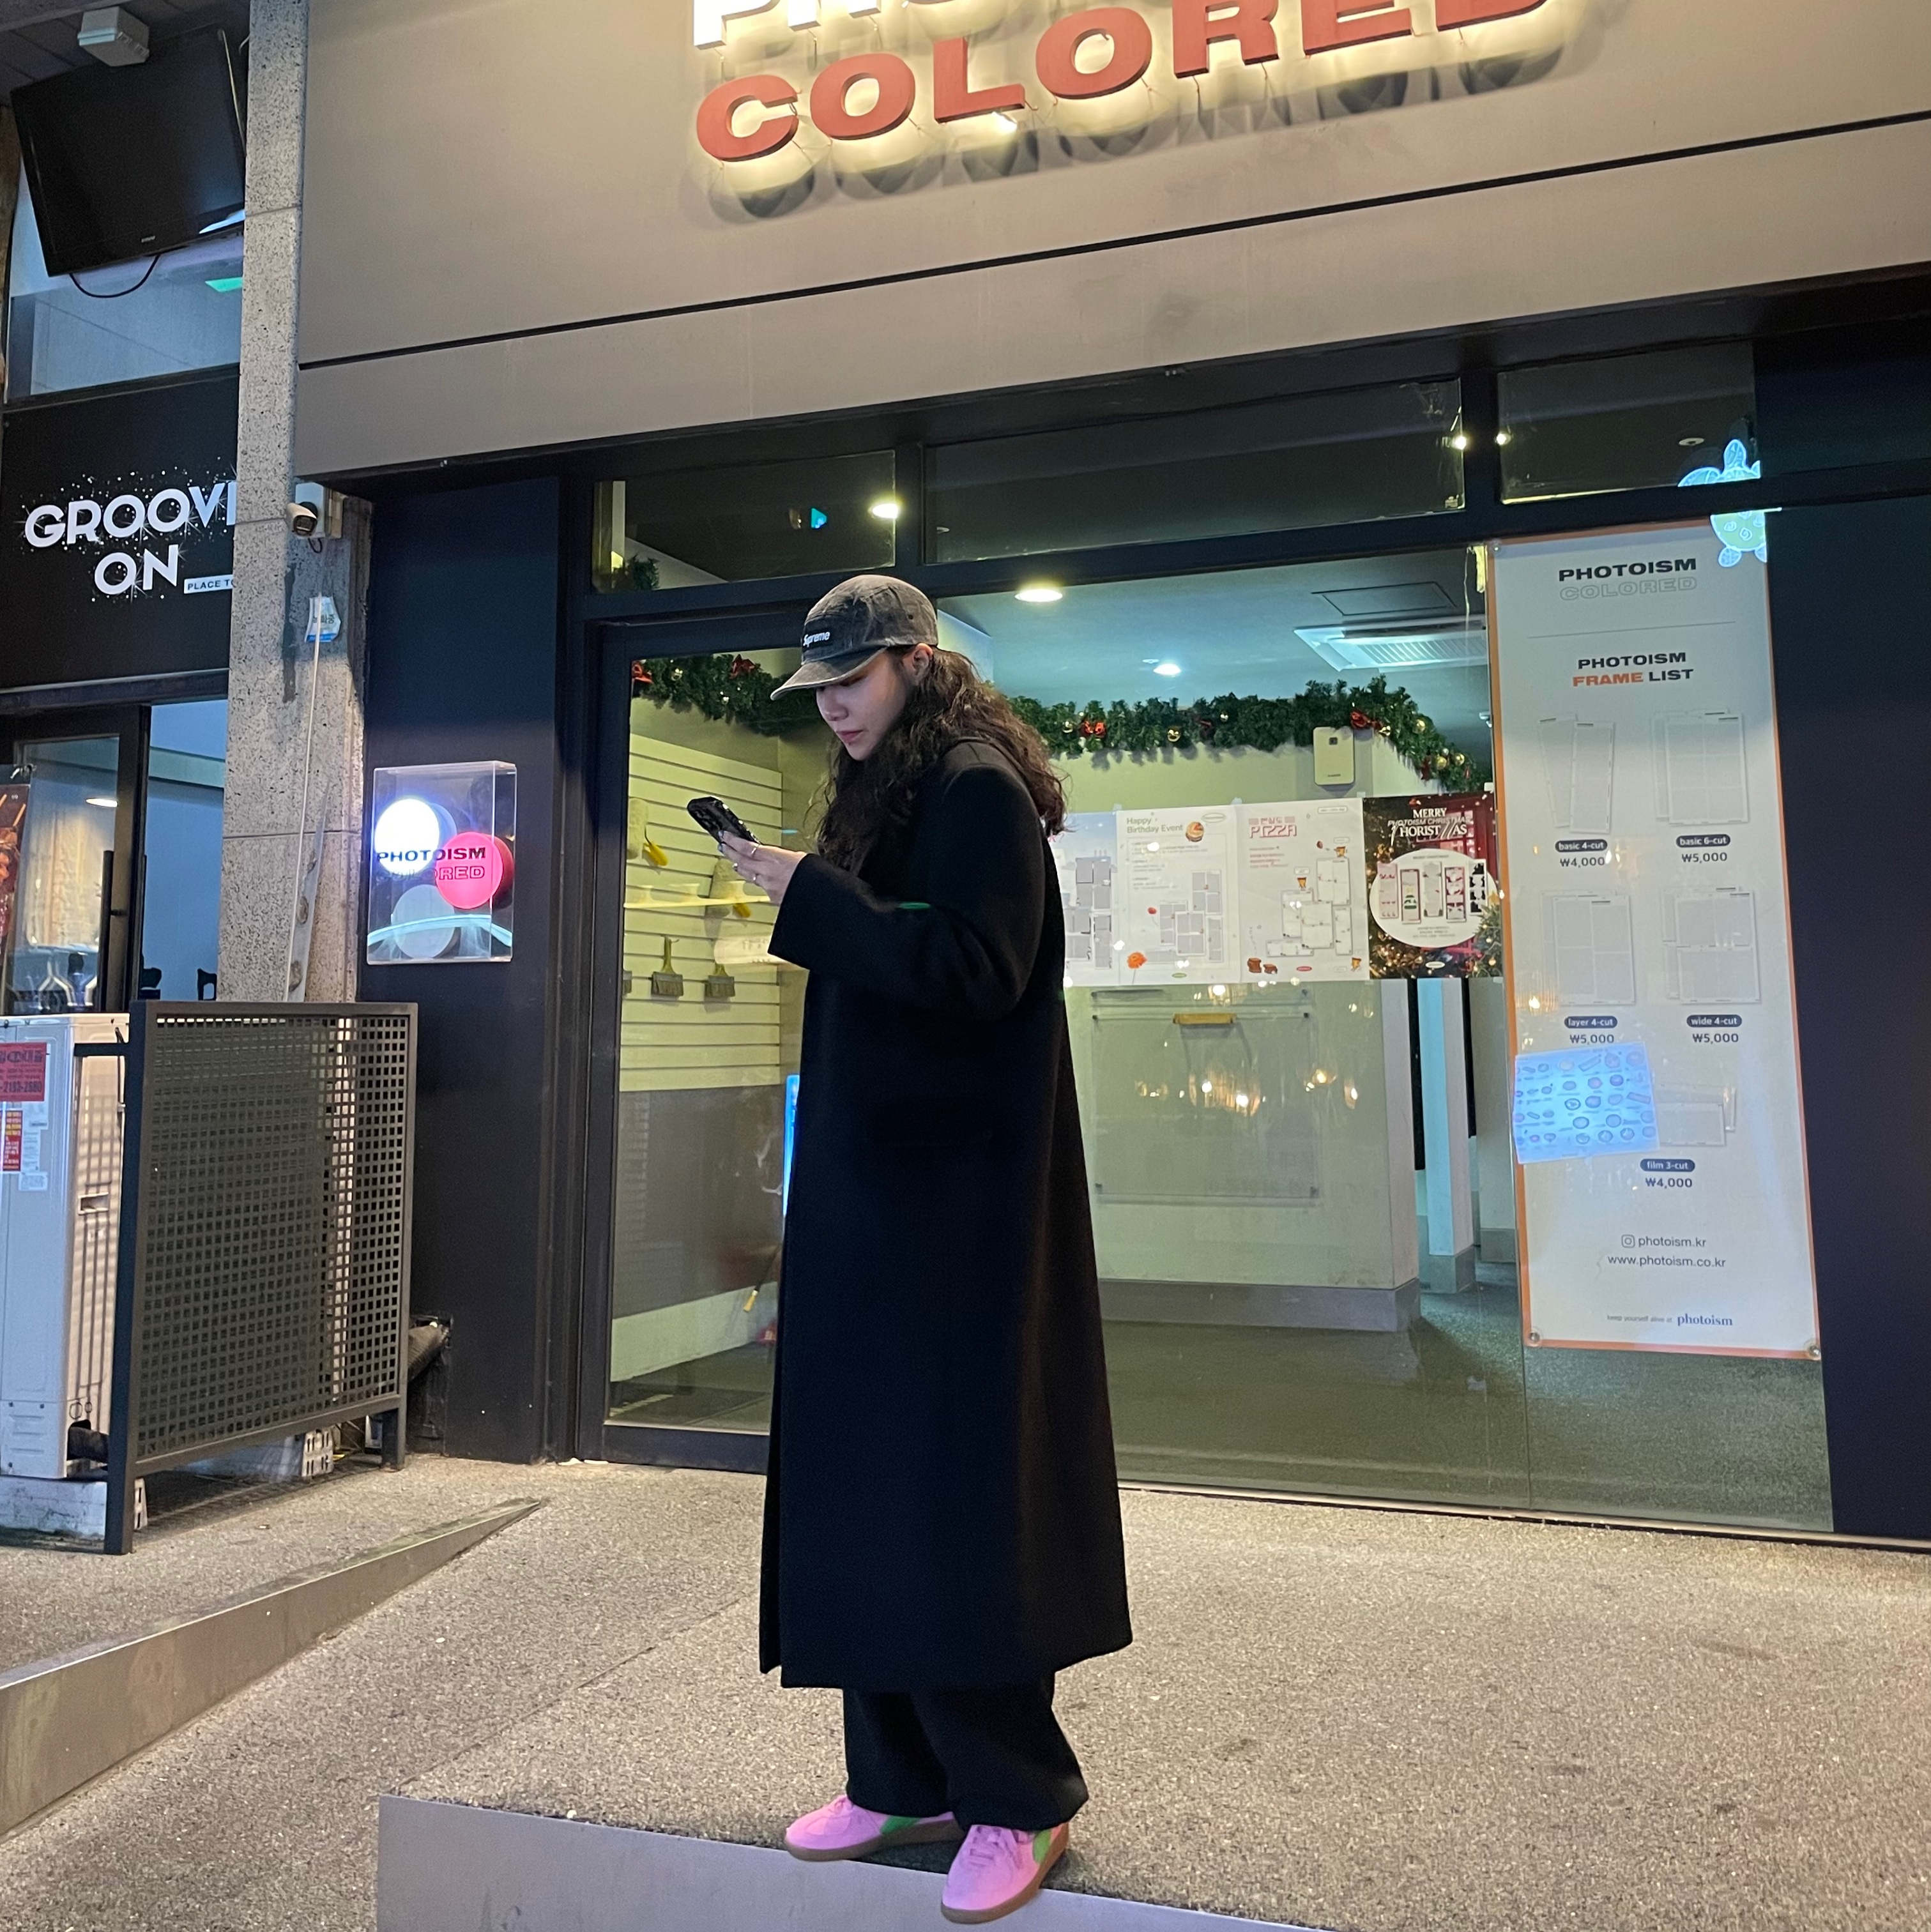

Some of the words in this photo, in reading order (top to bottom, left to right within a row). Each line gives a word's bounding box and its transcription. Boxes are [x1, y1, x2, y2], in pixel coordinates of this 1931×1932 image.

[94, 544, 179, 595] ON
[1559, 558, 1697, 582] PHOTOISM
[187, 580, 221, 591] PLACE
[1559, 576, 1698, 600] COLORED
[803, 632, 830, 648] Supreme
[1578, 652, 1686, 670] PHOTOISM
[1573, 673, 1644, 687] FRAME
[1649, 669, 1694, 681] LIST
[1413, 807, 1447, 819] MERRY
[1127, 826, 1159, 834] Birthday
[1161, 824, 1183, 832] Event
[1249, 825, 1297, 839] PIZZA
[1558, 842, 1580, 851] basic
[1582, 841, 1605, 850] 4-cut
[1679, 837, 1702, 846] basic
[1704, 836, 1727, 845] 6-cut
[377, 847, 486, 862] PHOTOISM
[1568, 1018, 1589, 1028] layer
[1591, 1018, 1614, 1026] 4-cut
[1691, 1017, 1713, 1025] wide
[1714, 1017, 1737, 1025] 4-cut
[1647, 1161, 1664, 1169] film
[1665, 1161, 1688, 1169] 3-cut
[1638, 1236, 1707, 1247] photoism.kr
[1607, 1256, 1727, 1268] www.photoism.co.kr
[1677, 1313, 1733, 1327] photoism
